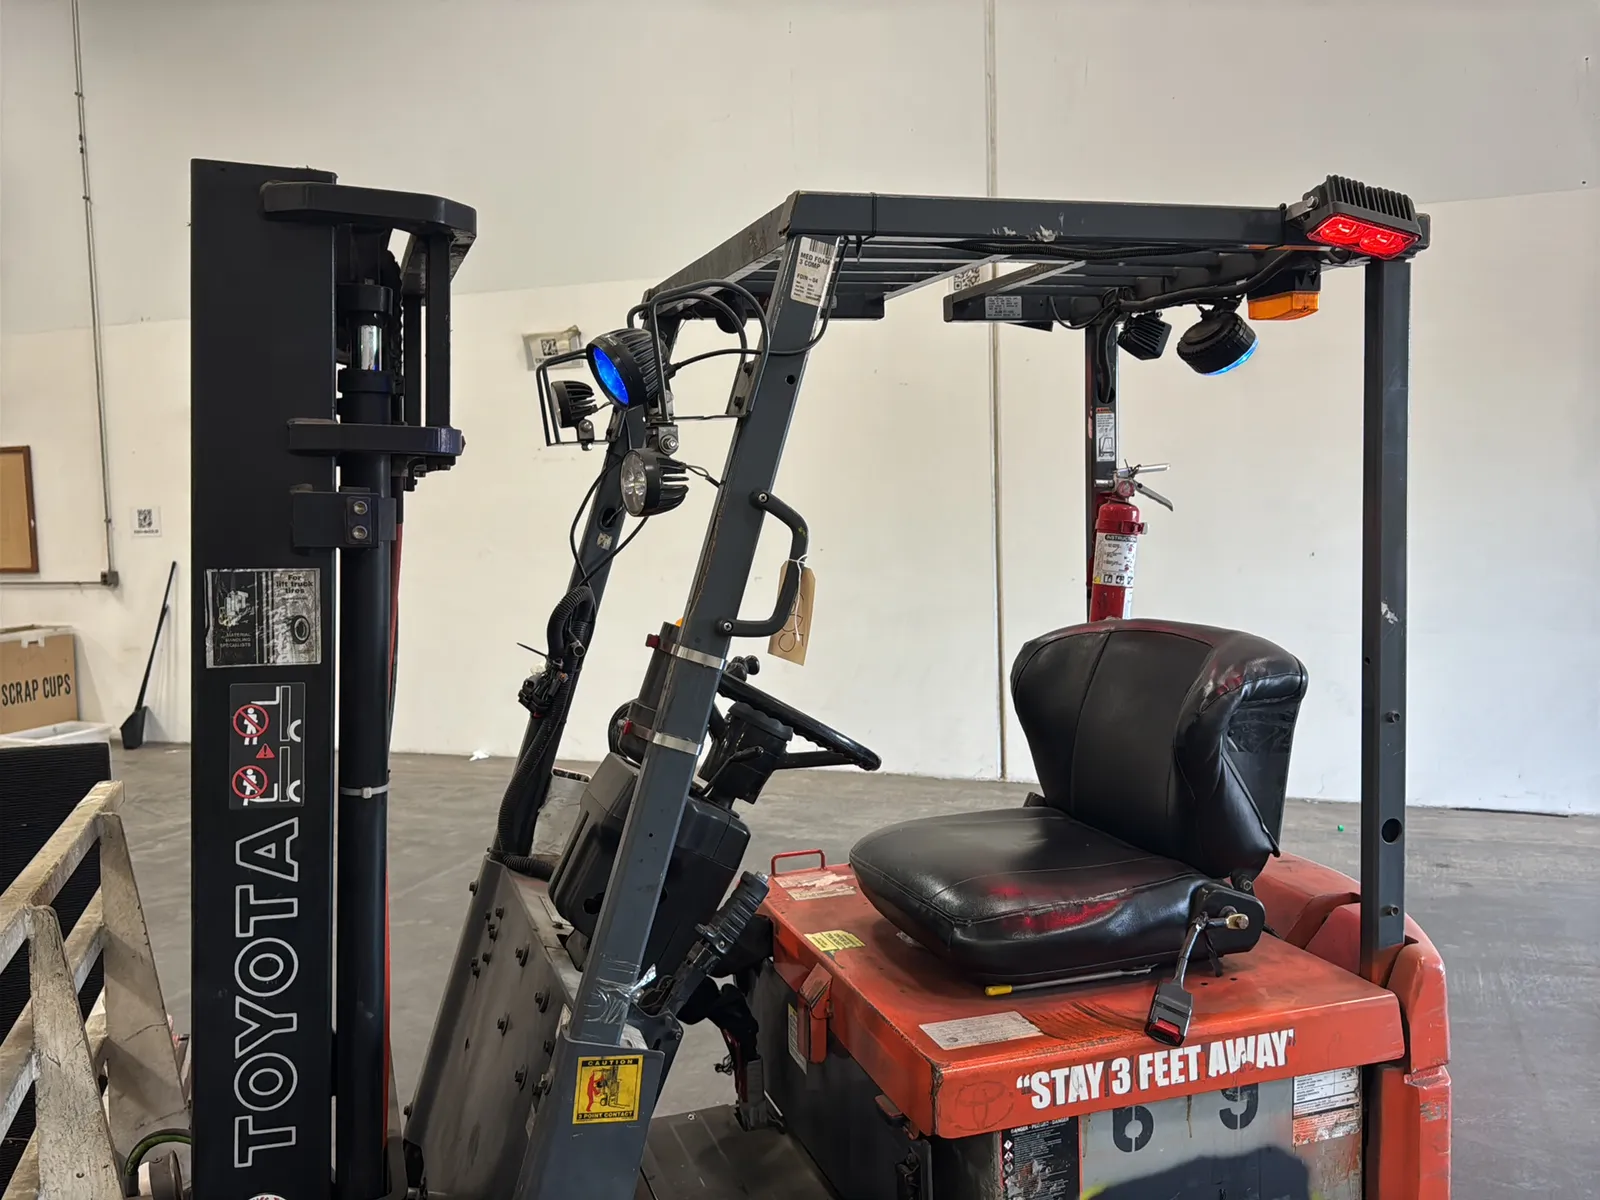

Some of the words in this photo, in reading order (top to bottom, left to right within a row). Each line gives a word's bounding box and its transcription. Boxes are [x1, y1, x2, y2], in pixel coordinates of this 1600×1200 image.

[800, 252, 813, 260] MED
[814, 256, 830, 265] FOAM
[804, 260, 821, 269] COMP
[290, 580, 314, 588] truck
[1, 679, 39, 707] SCRAP
[42, 673, 71, 699] CUPS
[233, 817, 299, 1168] TOYOTA
[1111, 1058, 1131, 1095] 3
[1139, 1045, 1202, 1090] FEET
